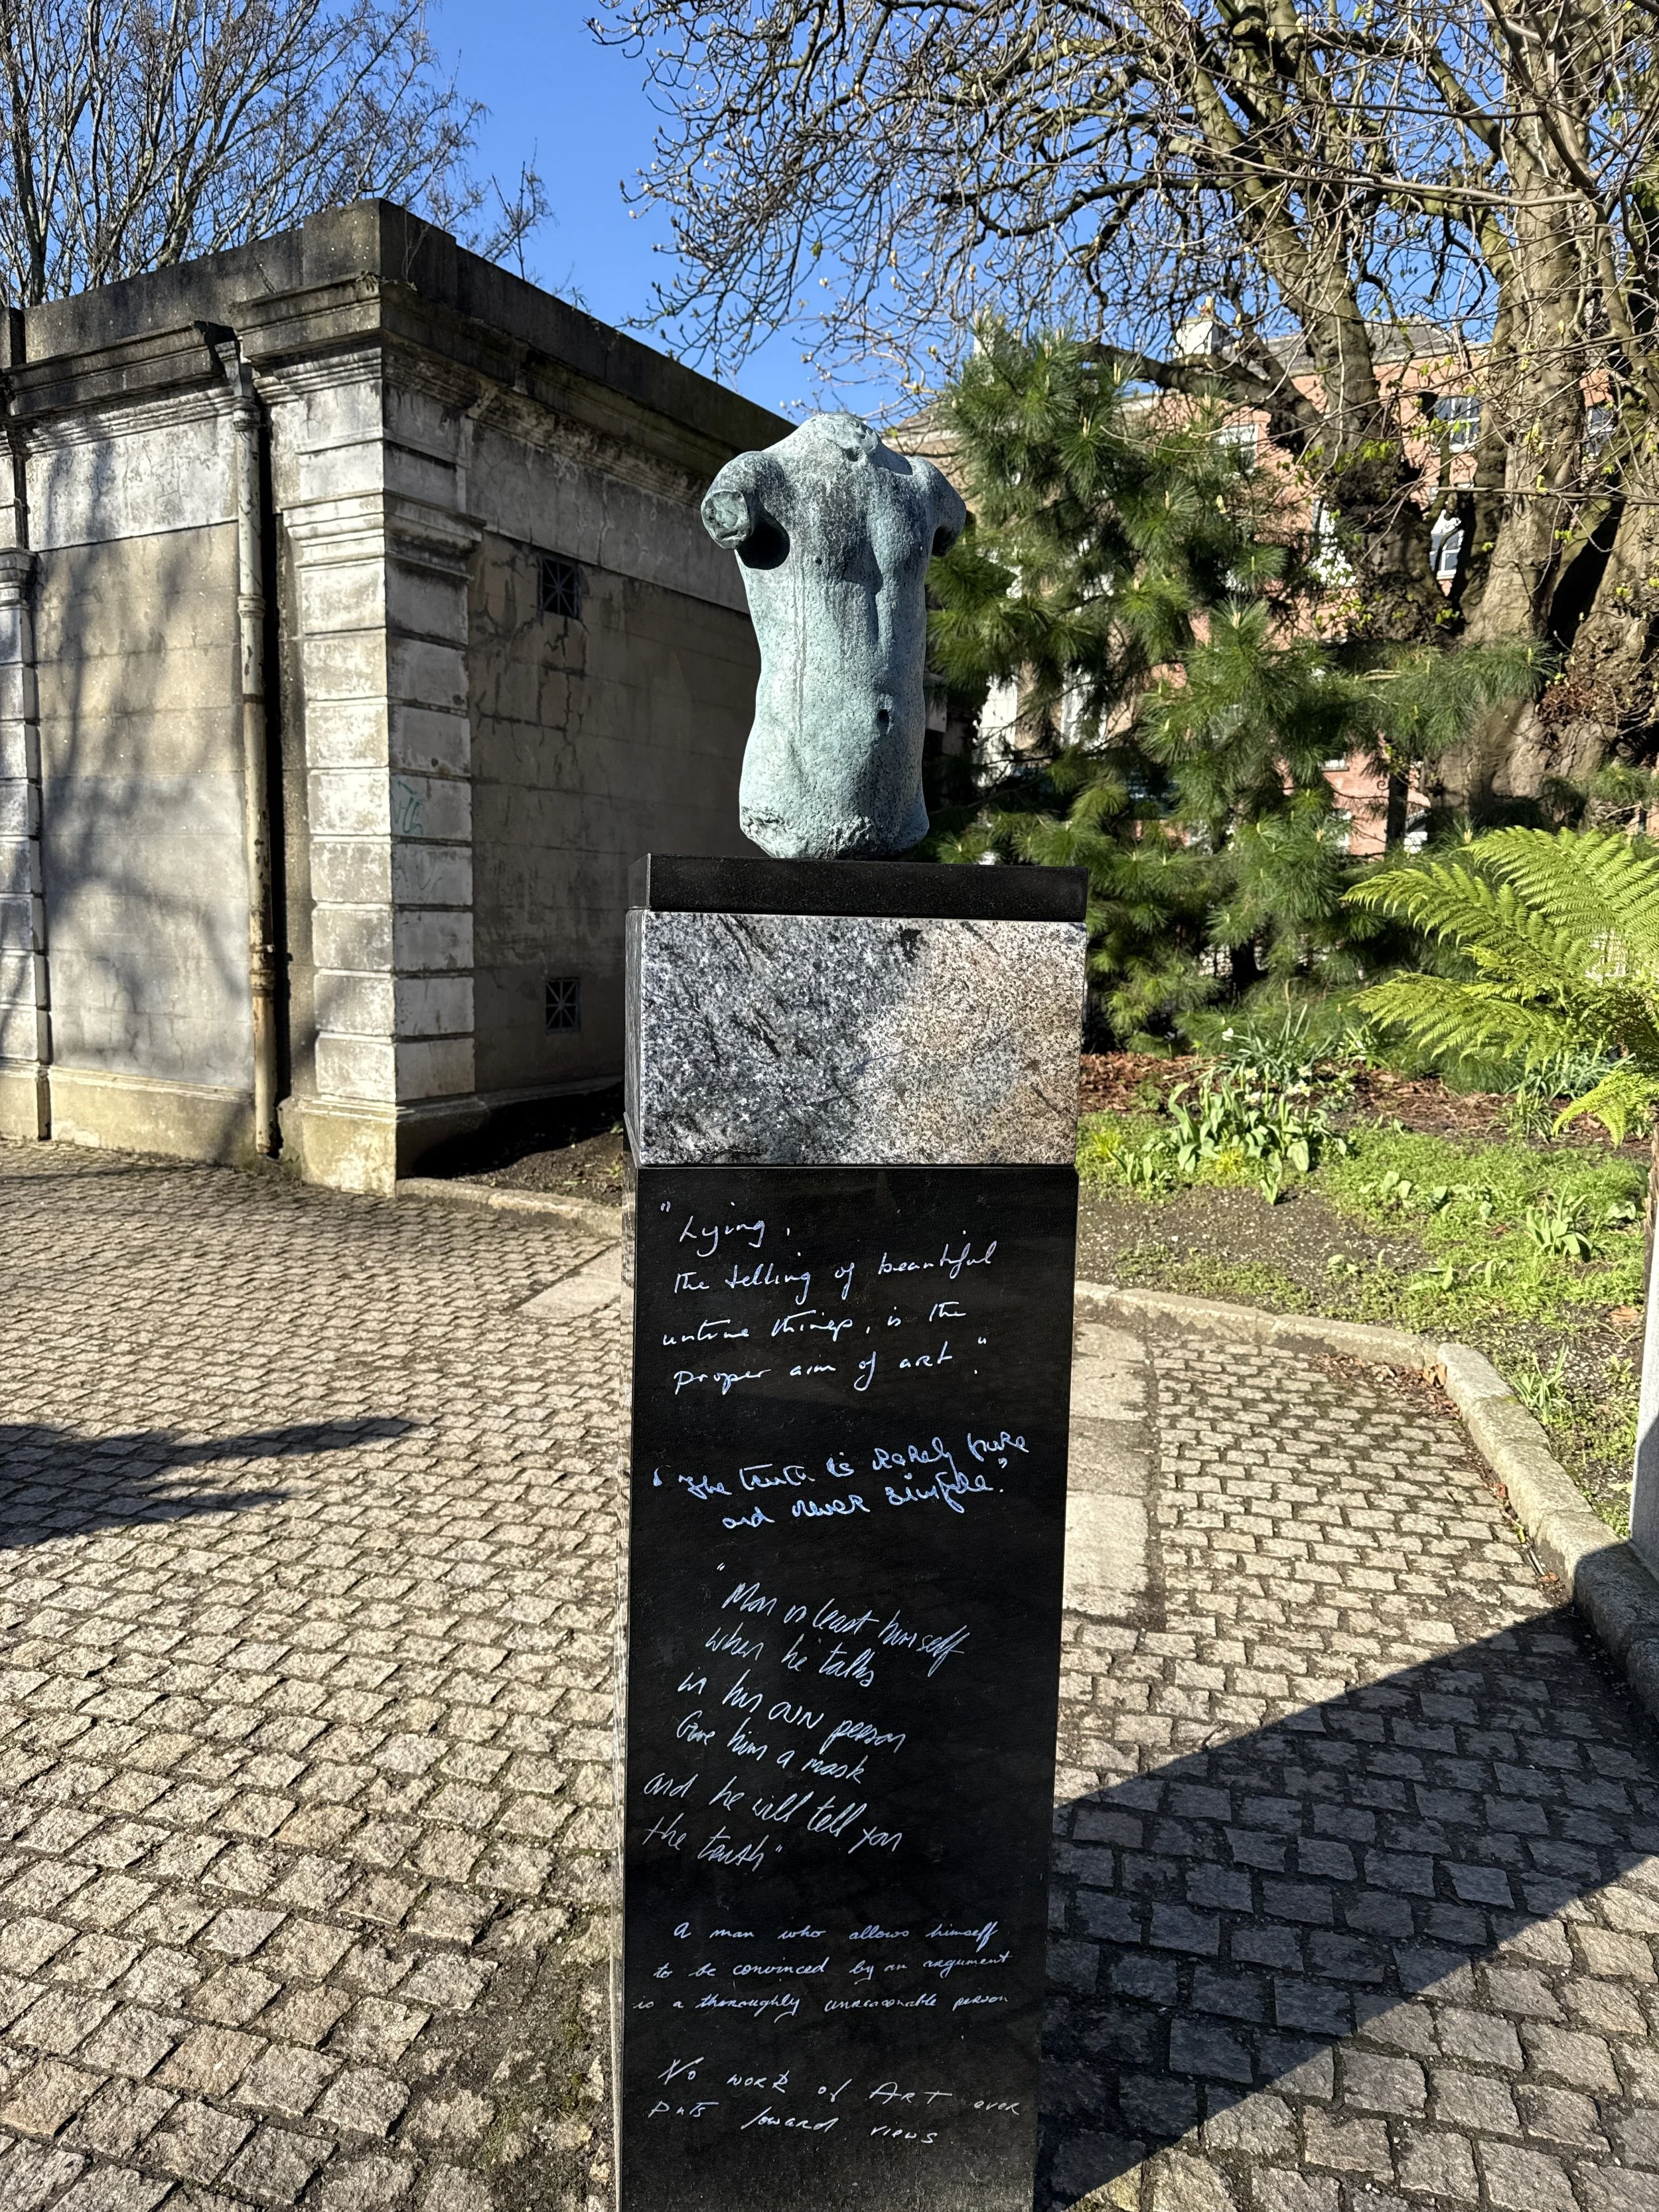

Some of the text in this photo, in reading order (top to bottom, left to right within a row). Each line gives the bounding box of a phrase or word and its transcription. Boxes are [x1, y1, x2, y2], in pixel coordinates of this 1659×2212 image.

[675, 1230, 998, 1303] The telling of beautiful
[662, 1319, 749, 1347] untrue
[887, 1306, 901, 1327] is
[789, 1354, 836, 1376] aim
[853, 1351, 876, 1391] of
[826, 1452, 855, 1477] is
[722, 1506, 775, 1529] and
[792, 1493, 871, 1517] never
[705, 1621, 875, 1687] when he talks
[812, 1597, 879, 1635] least
[877, 1609, 970, 1678] himself
[677, 1666, 705, 1696] in
[722, 1669, 762, 1713] his
[818, 1718, 906, 1753] person
[727, 1717, 766, 1760] him
[776, 1749, 794, 1769] a
[800, 1755, 868, 1785] mask
[644, 1772, 699, 1799] and
[709, 1775, 745, 1812] he
[751, 1791, 815, 1823] will
[806, 1795, 868, 1838] tell
[642, 1812, 684, 1852] the
[709, 1927, 755, 1939] man
[777, 1925, 827, 1939] who
[849, 1925, 910, 1940] allows
[925, 1921, 999, 1953] himself
[653, 1950, 1013, 1986] to be convinced by an argument
[632, 1992, 1010, 2024] is a thoroughly unreasonable person
[658, 2057, 703, 2085] No
[817, 2079, 852, 2102] of
[974, 2099, 1020, 2116] ever
[871, 2126, 937, 2144] views
